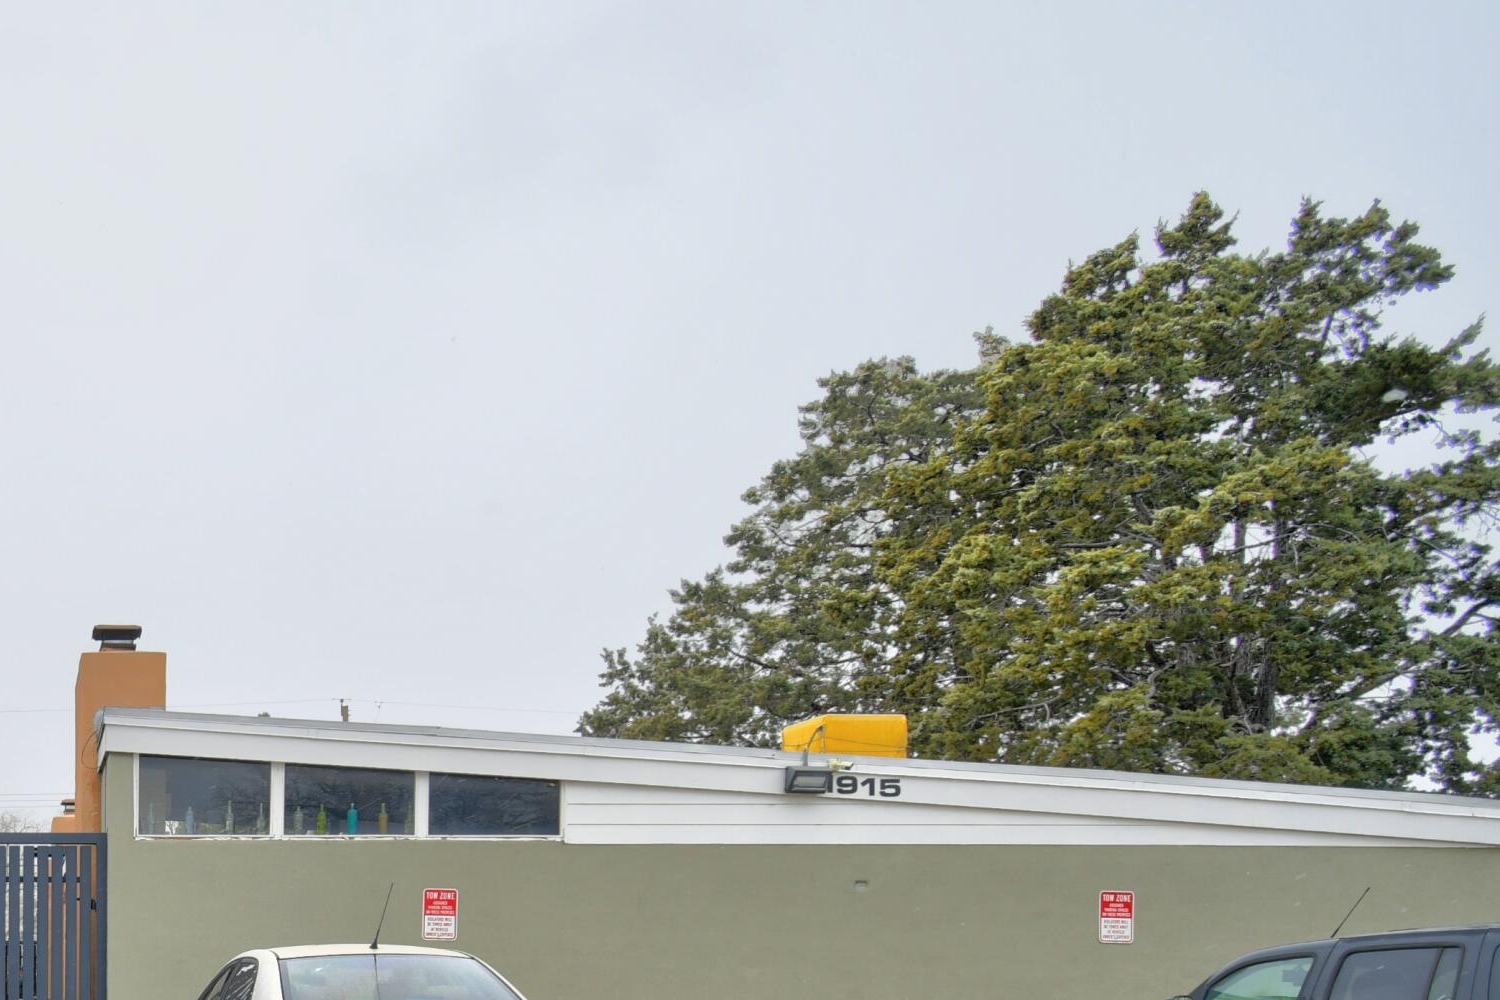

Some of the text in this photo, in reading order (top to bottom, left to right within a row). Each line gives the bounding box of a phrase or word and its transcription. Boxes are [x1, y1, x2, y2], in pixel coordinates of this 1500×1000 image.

[426, 891, 456, 900] TOW ZONE
[1103, 894, 1131, 902] TOW ZONE
